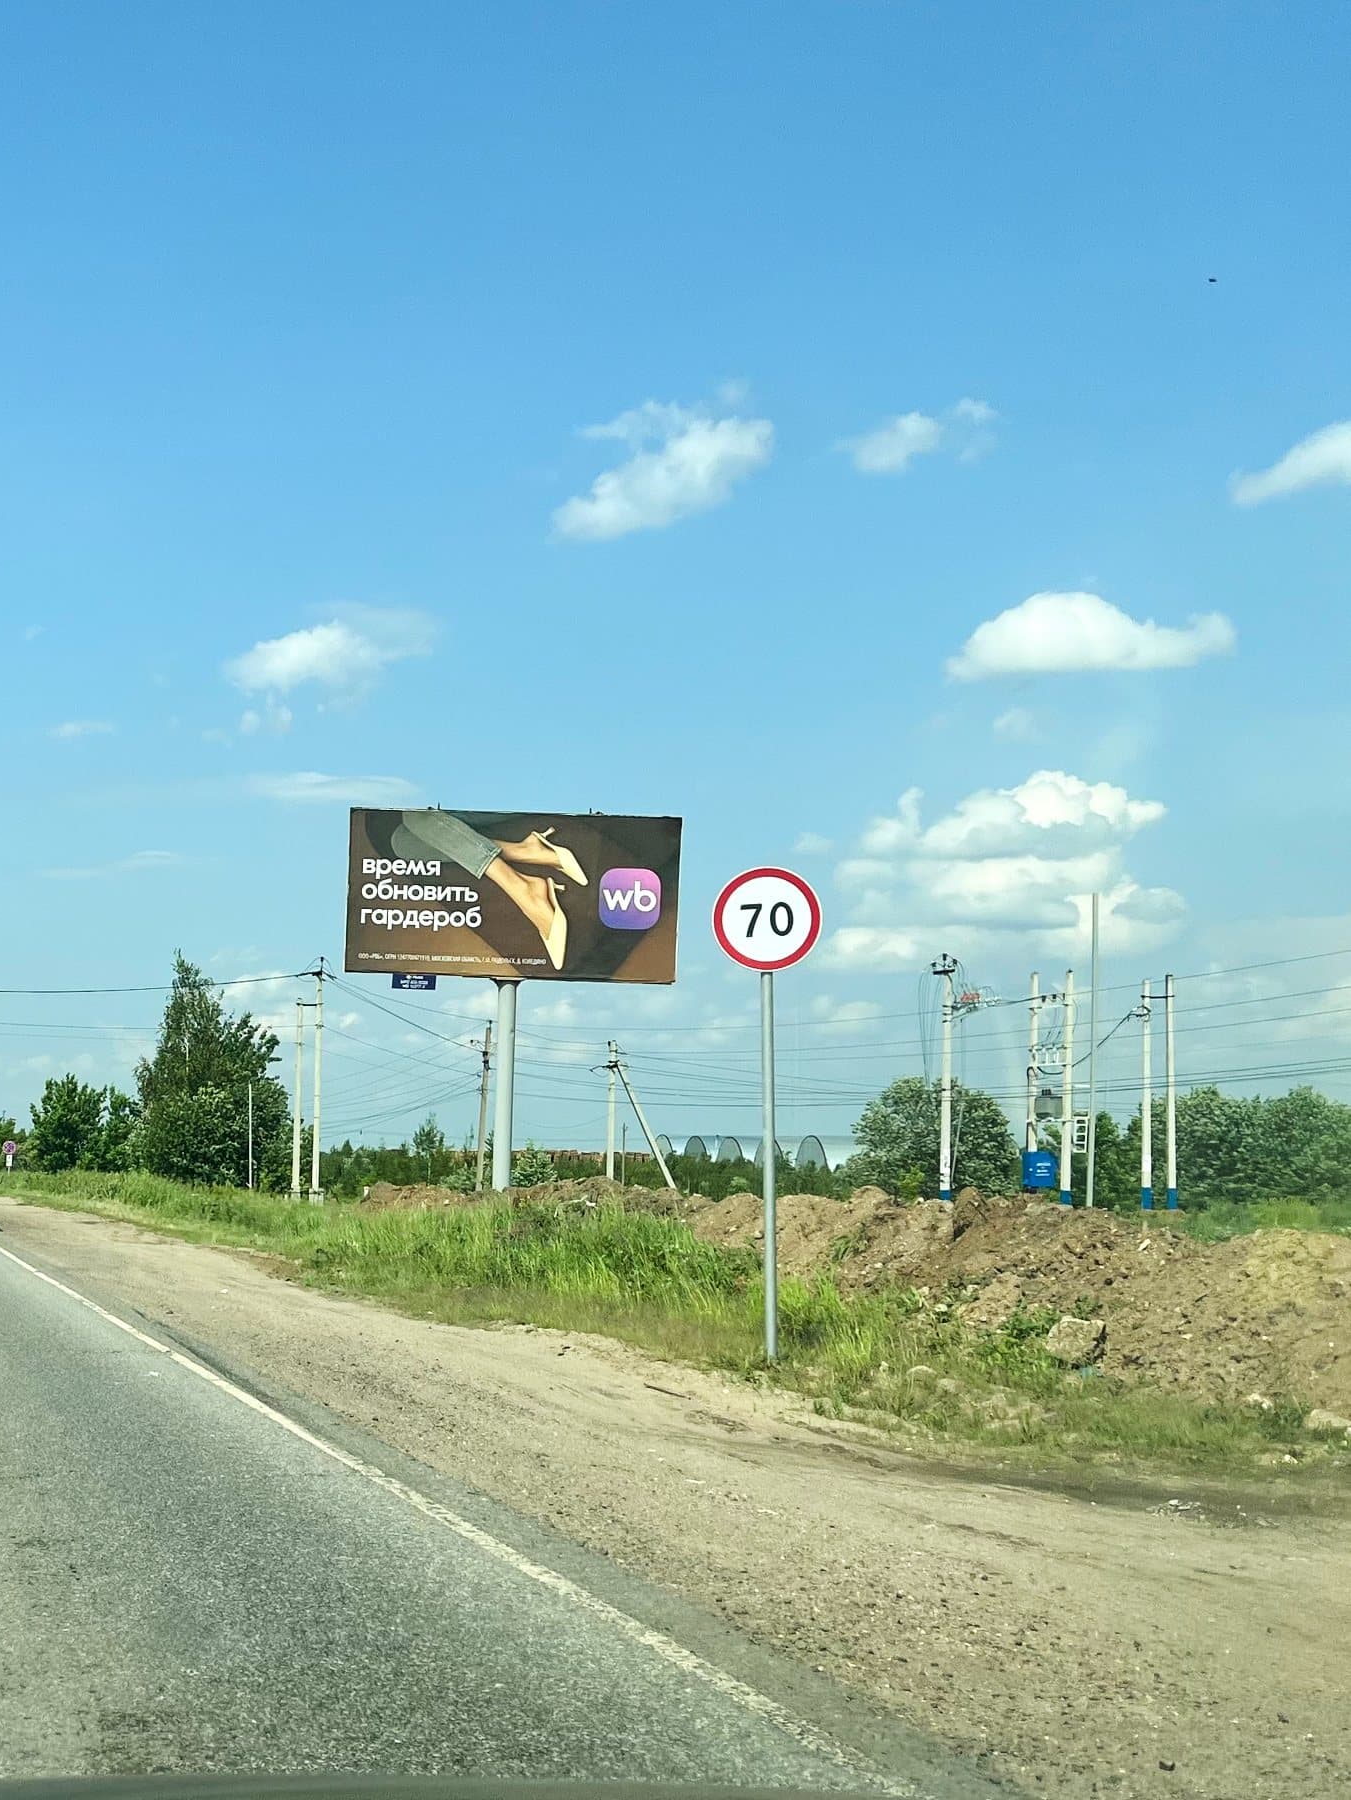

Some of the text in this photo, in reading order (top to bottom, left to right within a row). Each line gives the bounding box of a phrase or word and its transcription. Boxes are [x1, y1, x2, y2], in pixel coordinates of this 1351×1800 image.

[362, 858, 441, 879] время
[361, 878, 479, 902] обновить
[603, 881, 657, 912] wb
[360, 906, 482, 932] гардероб
[740, 901, 794, 938] 70
